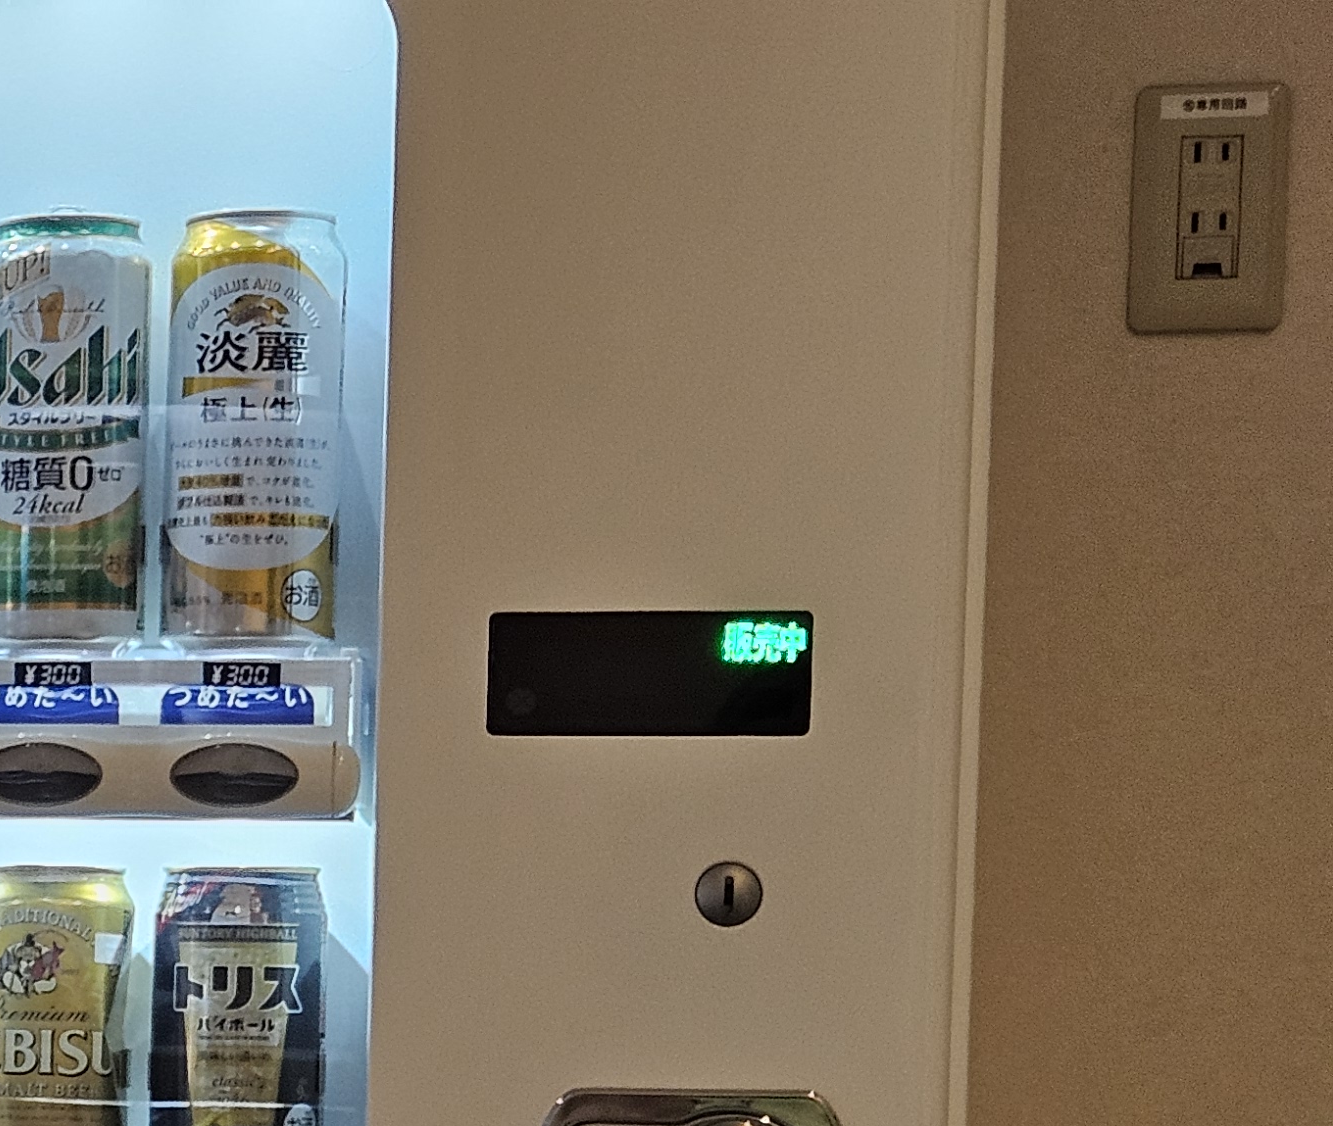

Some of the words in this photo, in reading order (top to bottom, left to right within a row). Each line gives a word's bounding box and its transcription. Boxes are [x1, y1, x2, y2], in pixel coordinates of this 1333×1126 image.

[4, 250, 46, 291] UP!
[196, 331, 309, 374] 淡麗
[13, 494, 85, 515] 24kcal
[285, 584, 319, 607] お酒
[724, 620, 808, 663] 販売中
[24, 665, 81, 685] ¥300
[212, 665, 269, 686] ¥300
[173, 964, 303, 1013] トリス
